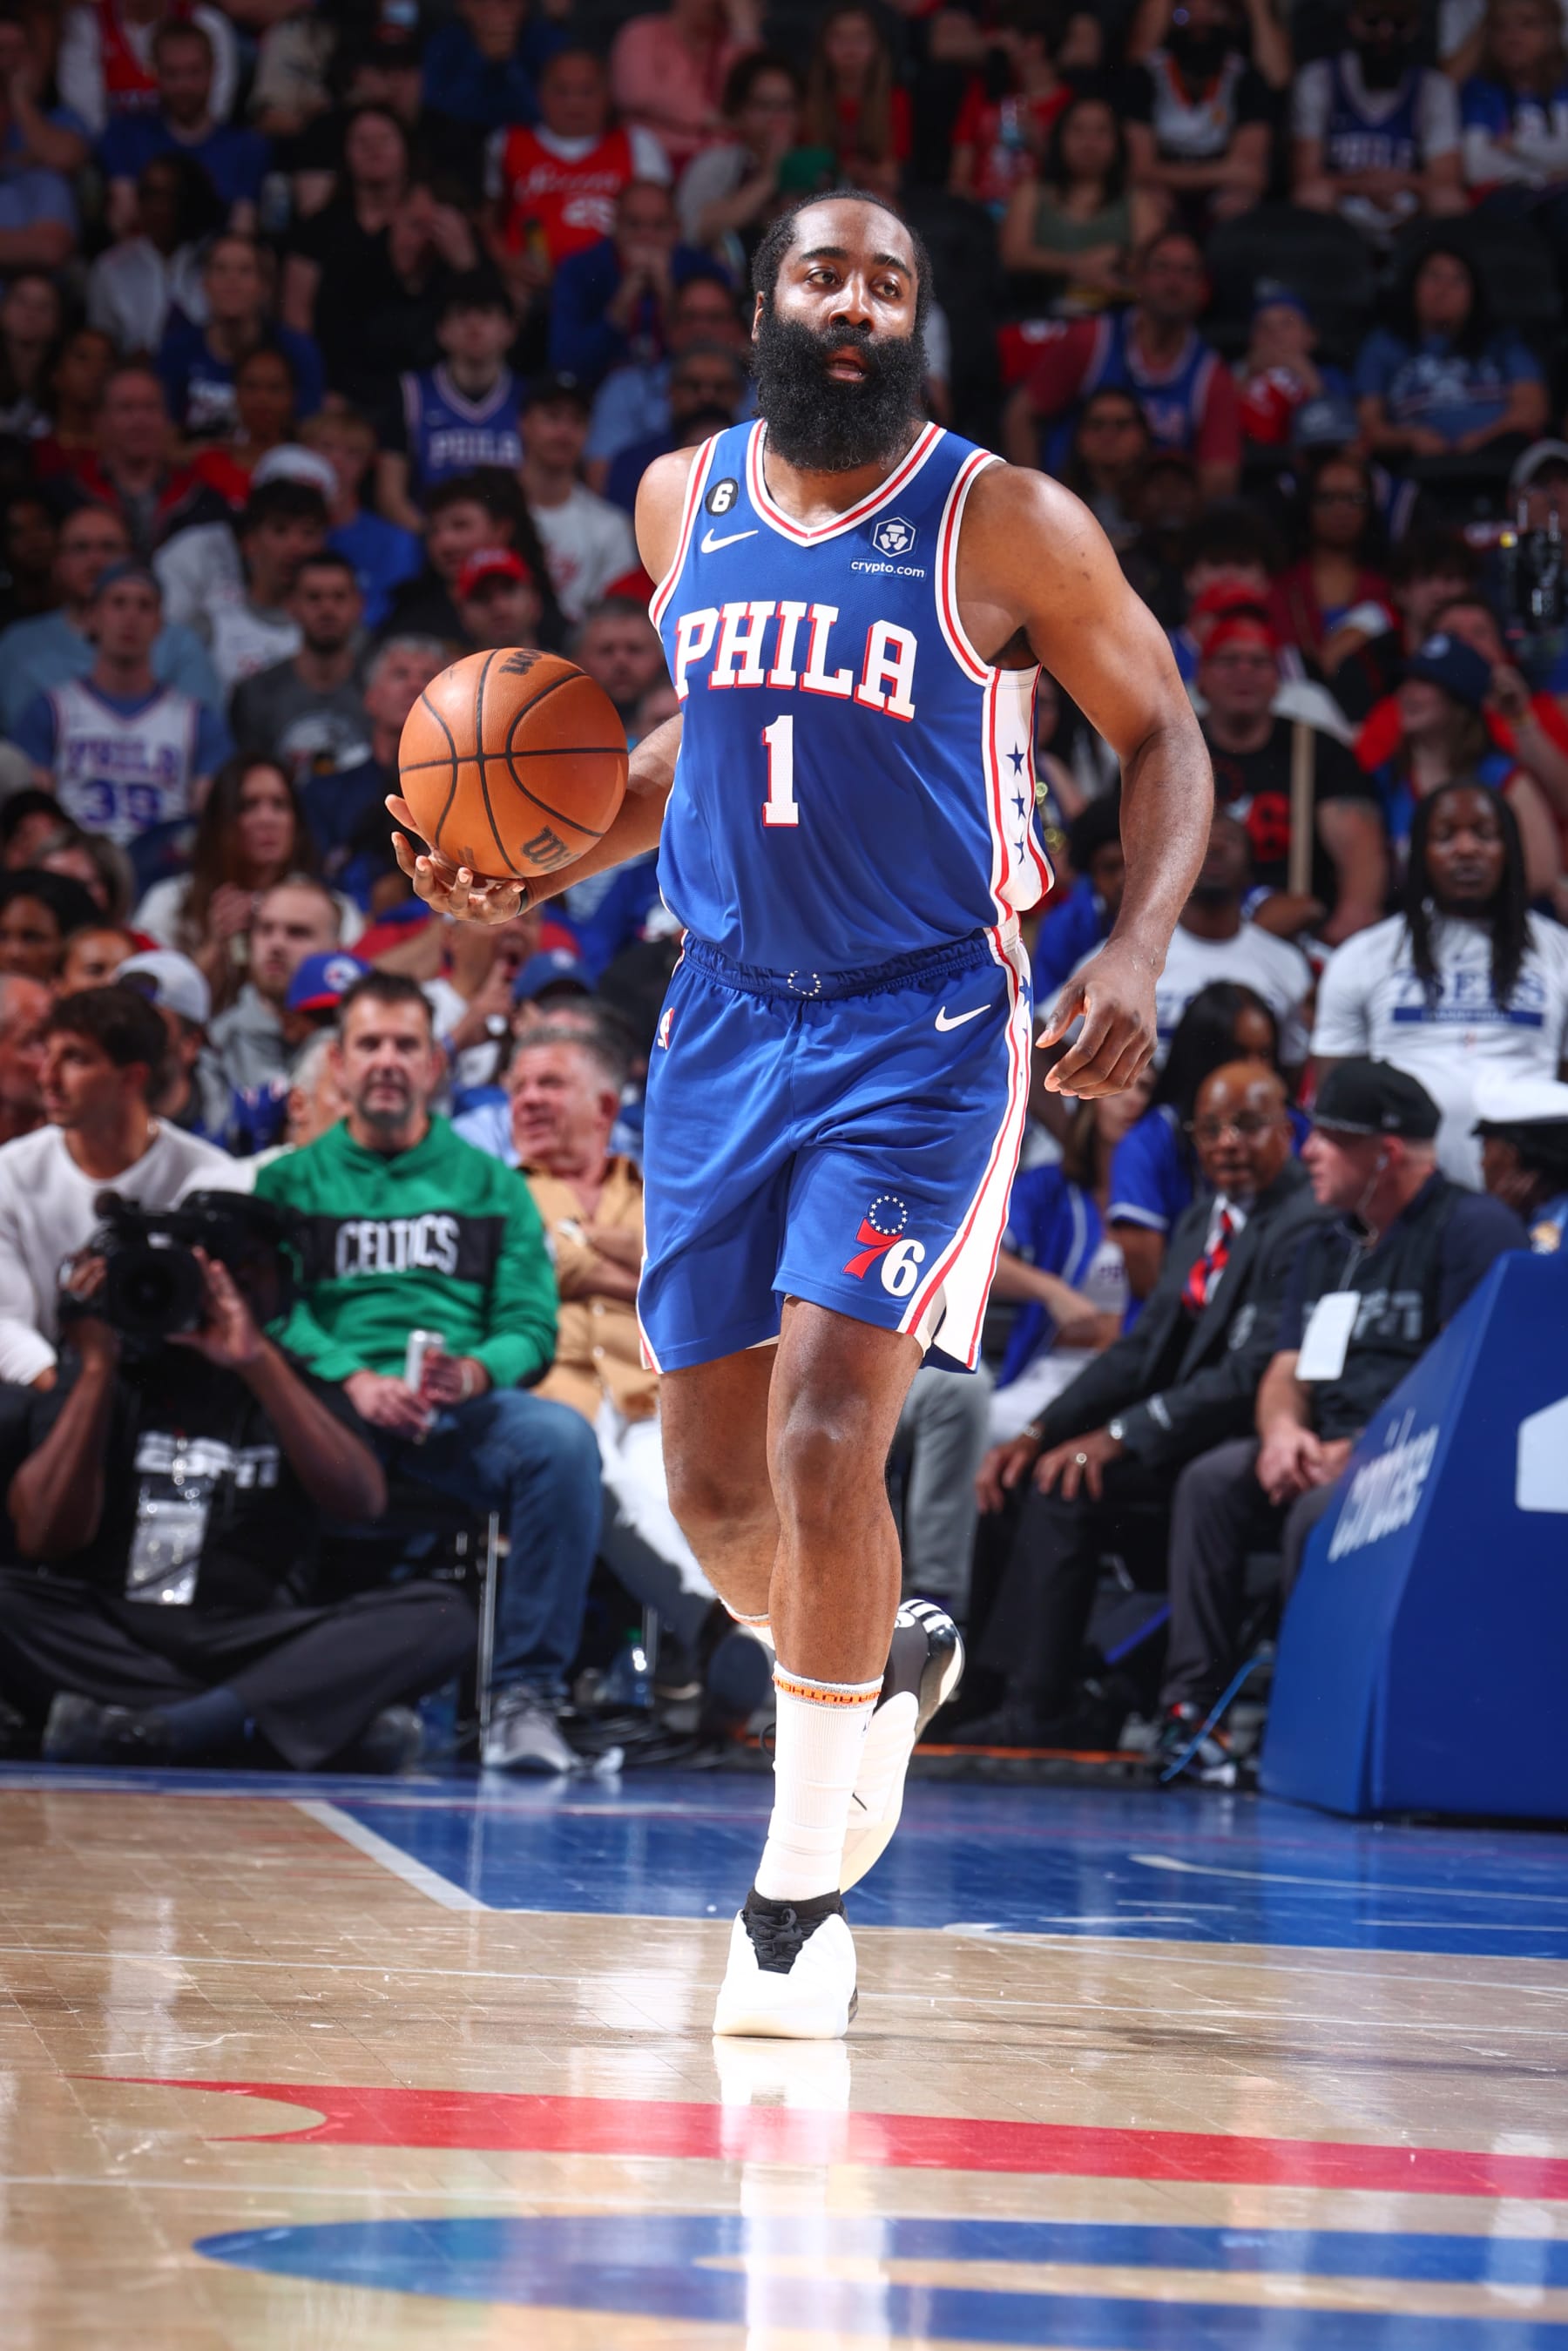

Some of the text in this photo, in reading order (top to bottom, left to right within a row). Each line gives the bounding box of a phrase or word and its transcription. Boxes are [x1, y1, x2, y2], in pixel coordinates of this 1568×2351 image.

[429, 427, 522, 469] PHILA
[711, 482, 734, 513] 6
[850, 559, 925, 578] crypto.com
[674, 600, 918, 724] PHILA
[762, 714, 800, 828] 1
[334, 1213, 460, 1279] CELTICS
[842, 1216, 926, 1297] 76
